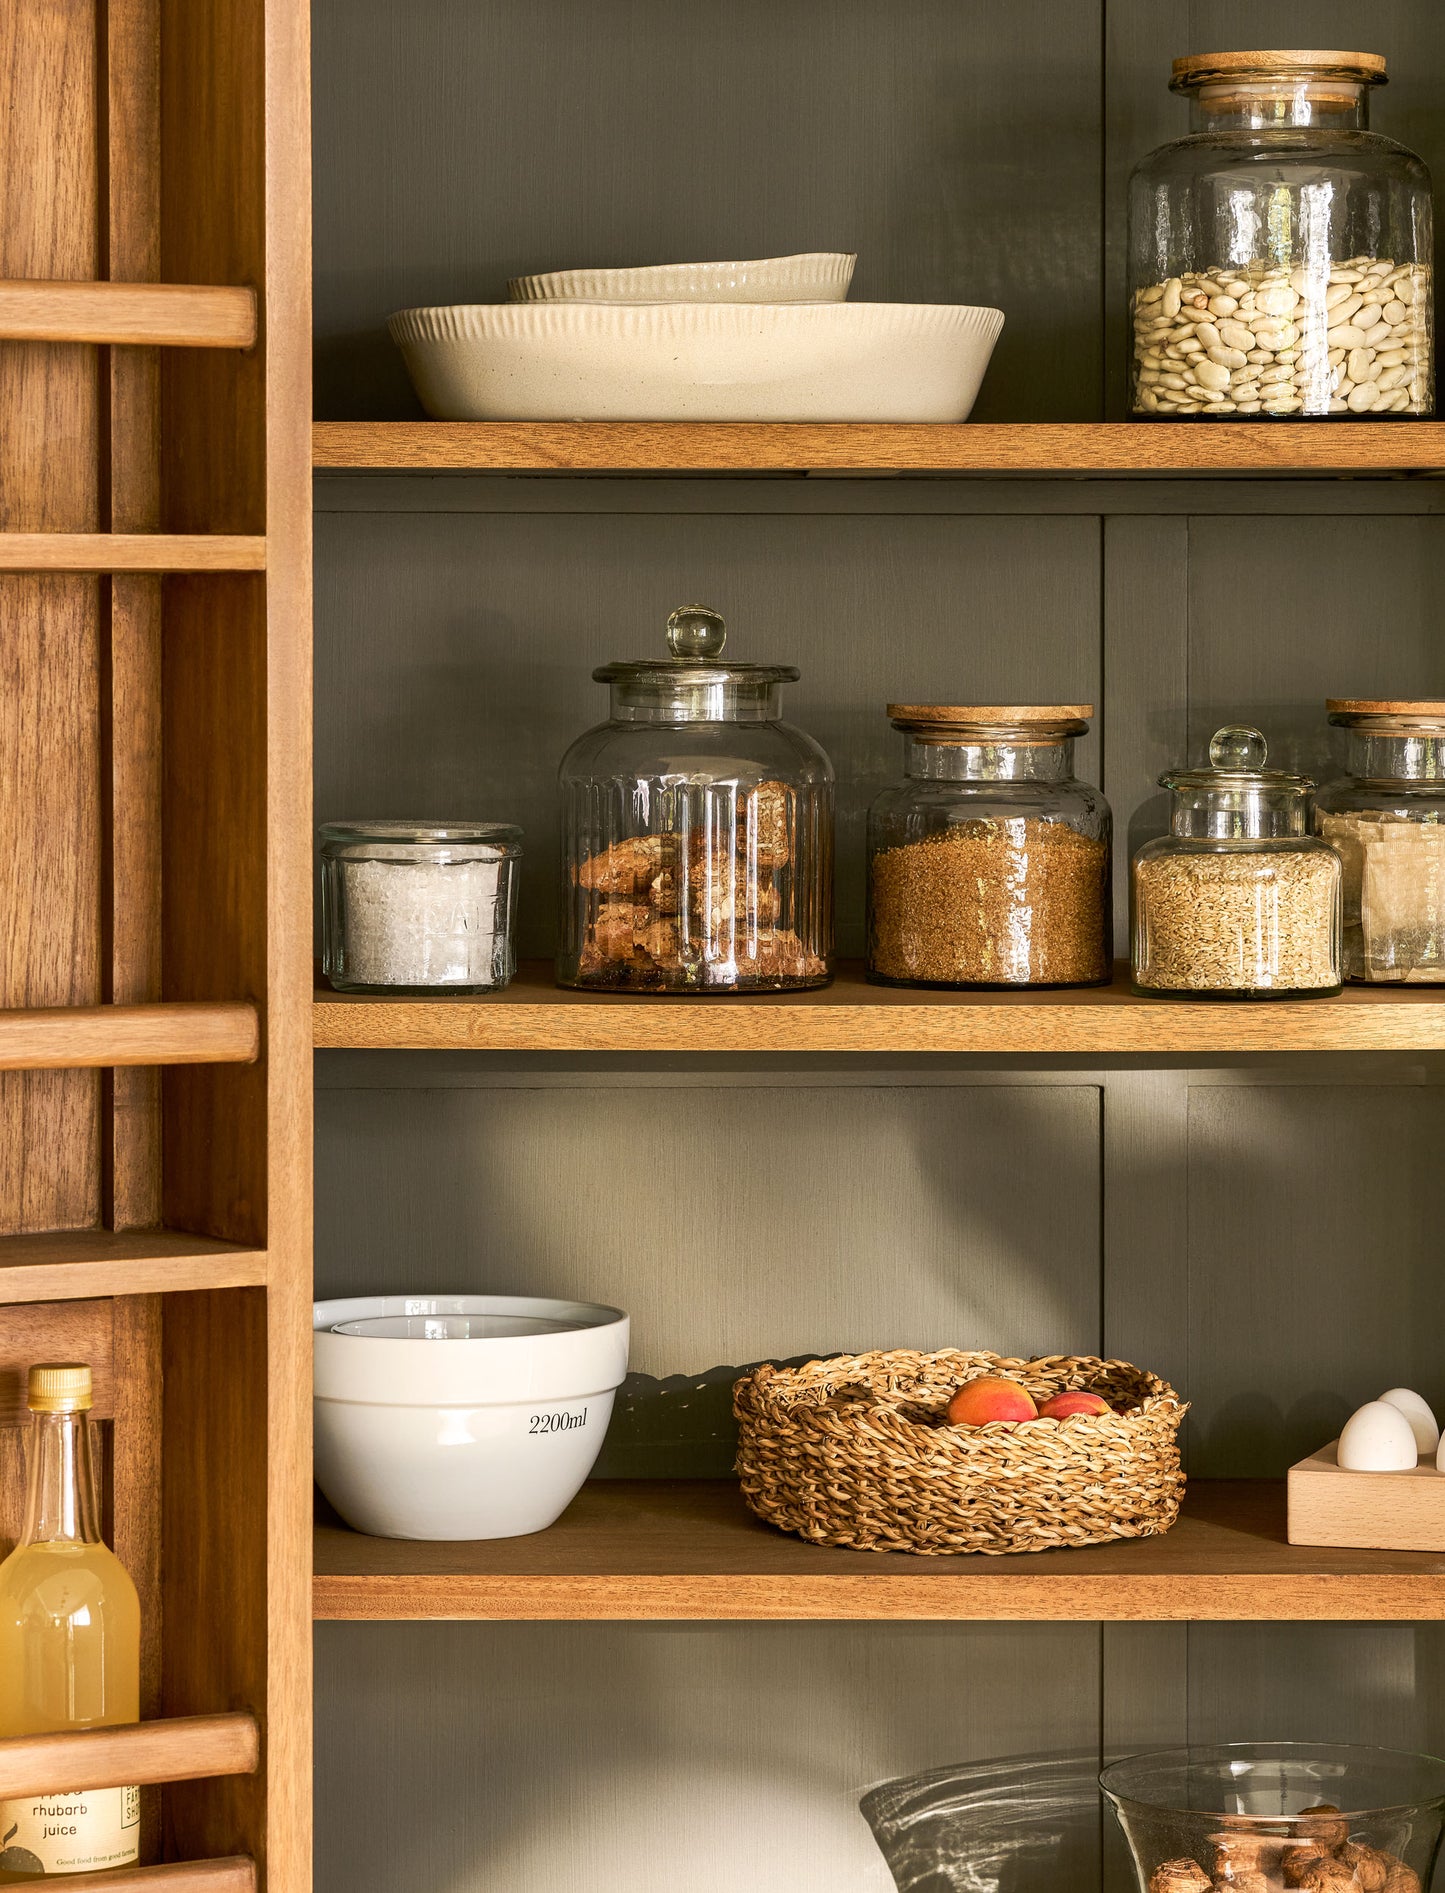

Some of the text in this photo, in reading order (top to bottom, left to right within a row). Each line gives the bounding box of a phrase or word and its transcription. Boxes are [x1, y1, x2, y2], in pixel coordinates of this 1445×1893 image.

[528, 1407, 588, 1434] 2200ml
[32, 1803, 88, 1817] rhubarb
[42, 1823, 77, 1840] juice
[56, 1857, 75, 1866] Good
[93, 1855, 108, 1863] from
